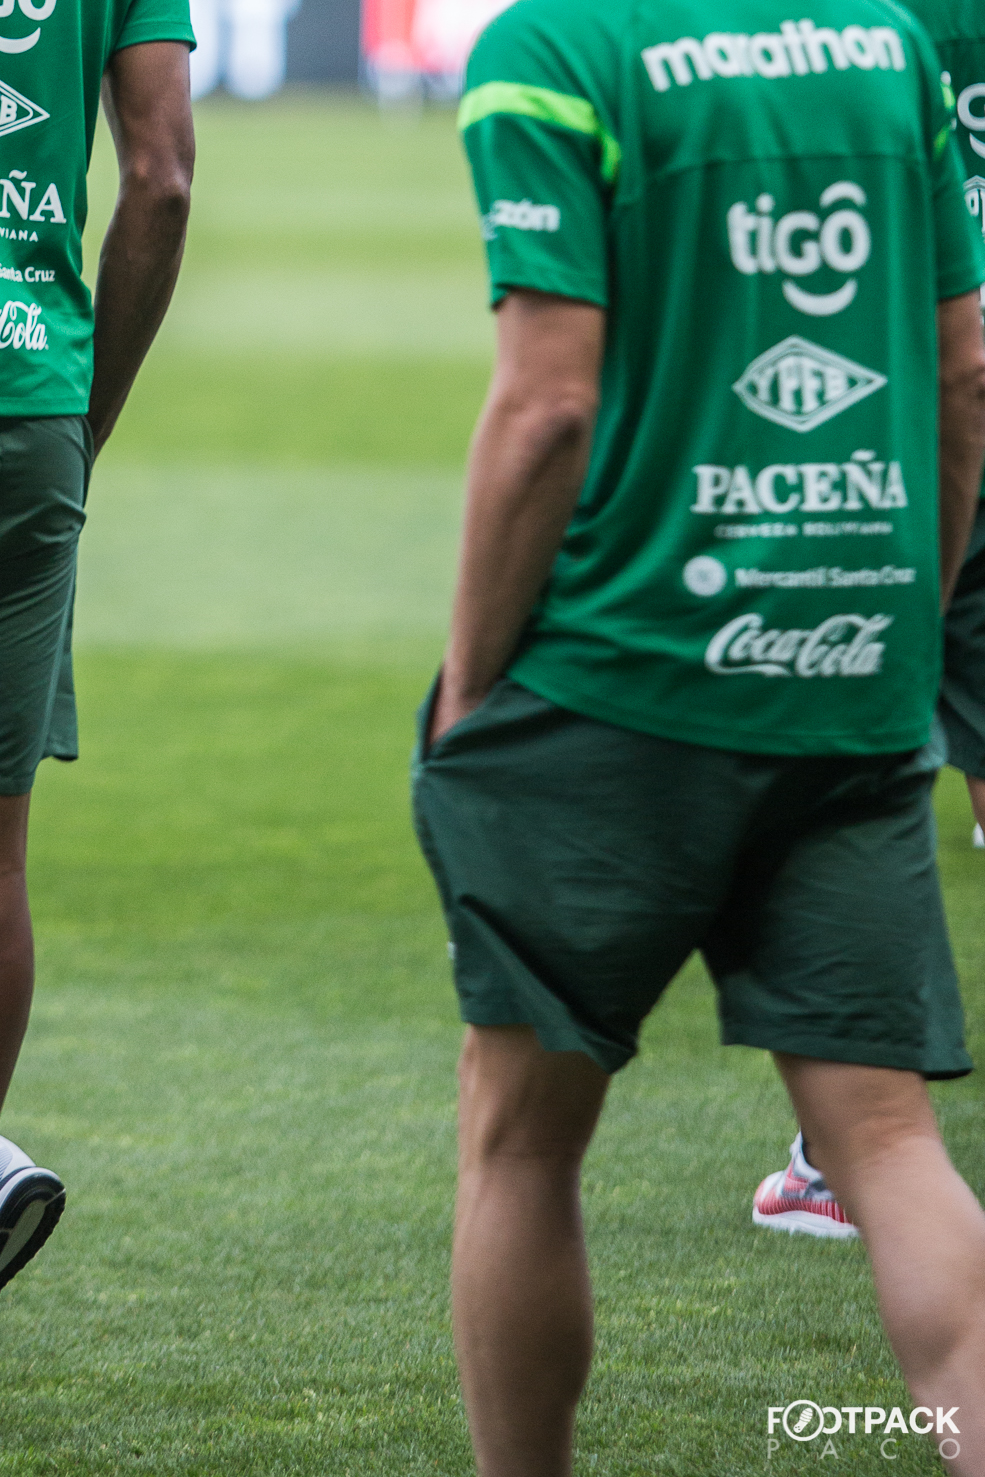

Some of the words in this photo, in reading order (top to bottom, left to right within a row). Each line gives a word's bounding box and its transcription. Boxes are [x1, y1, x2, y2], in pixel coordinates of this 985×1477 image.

[642, 18, 905, 92] marathon
[25, 267, 56, 283] Cruz
[691, 449, 908, 514] PACEÑA
